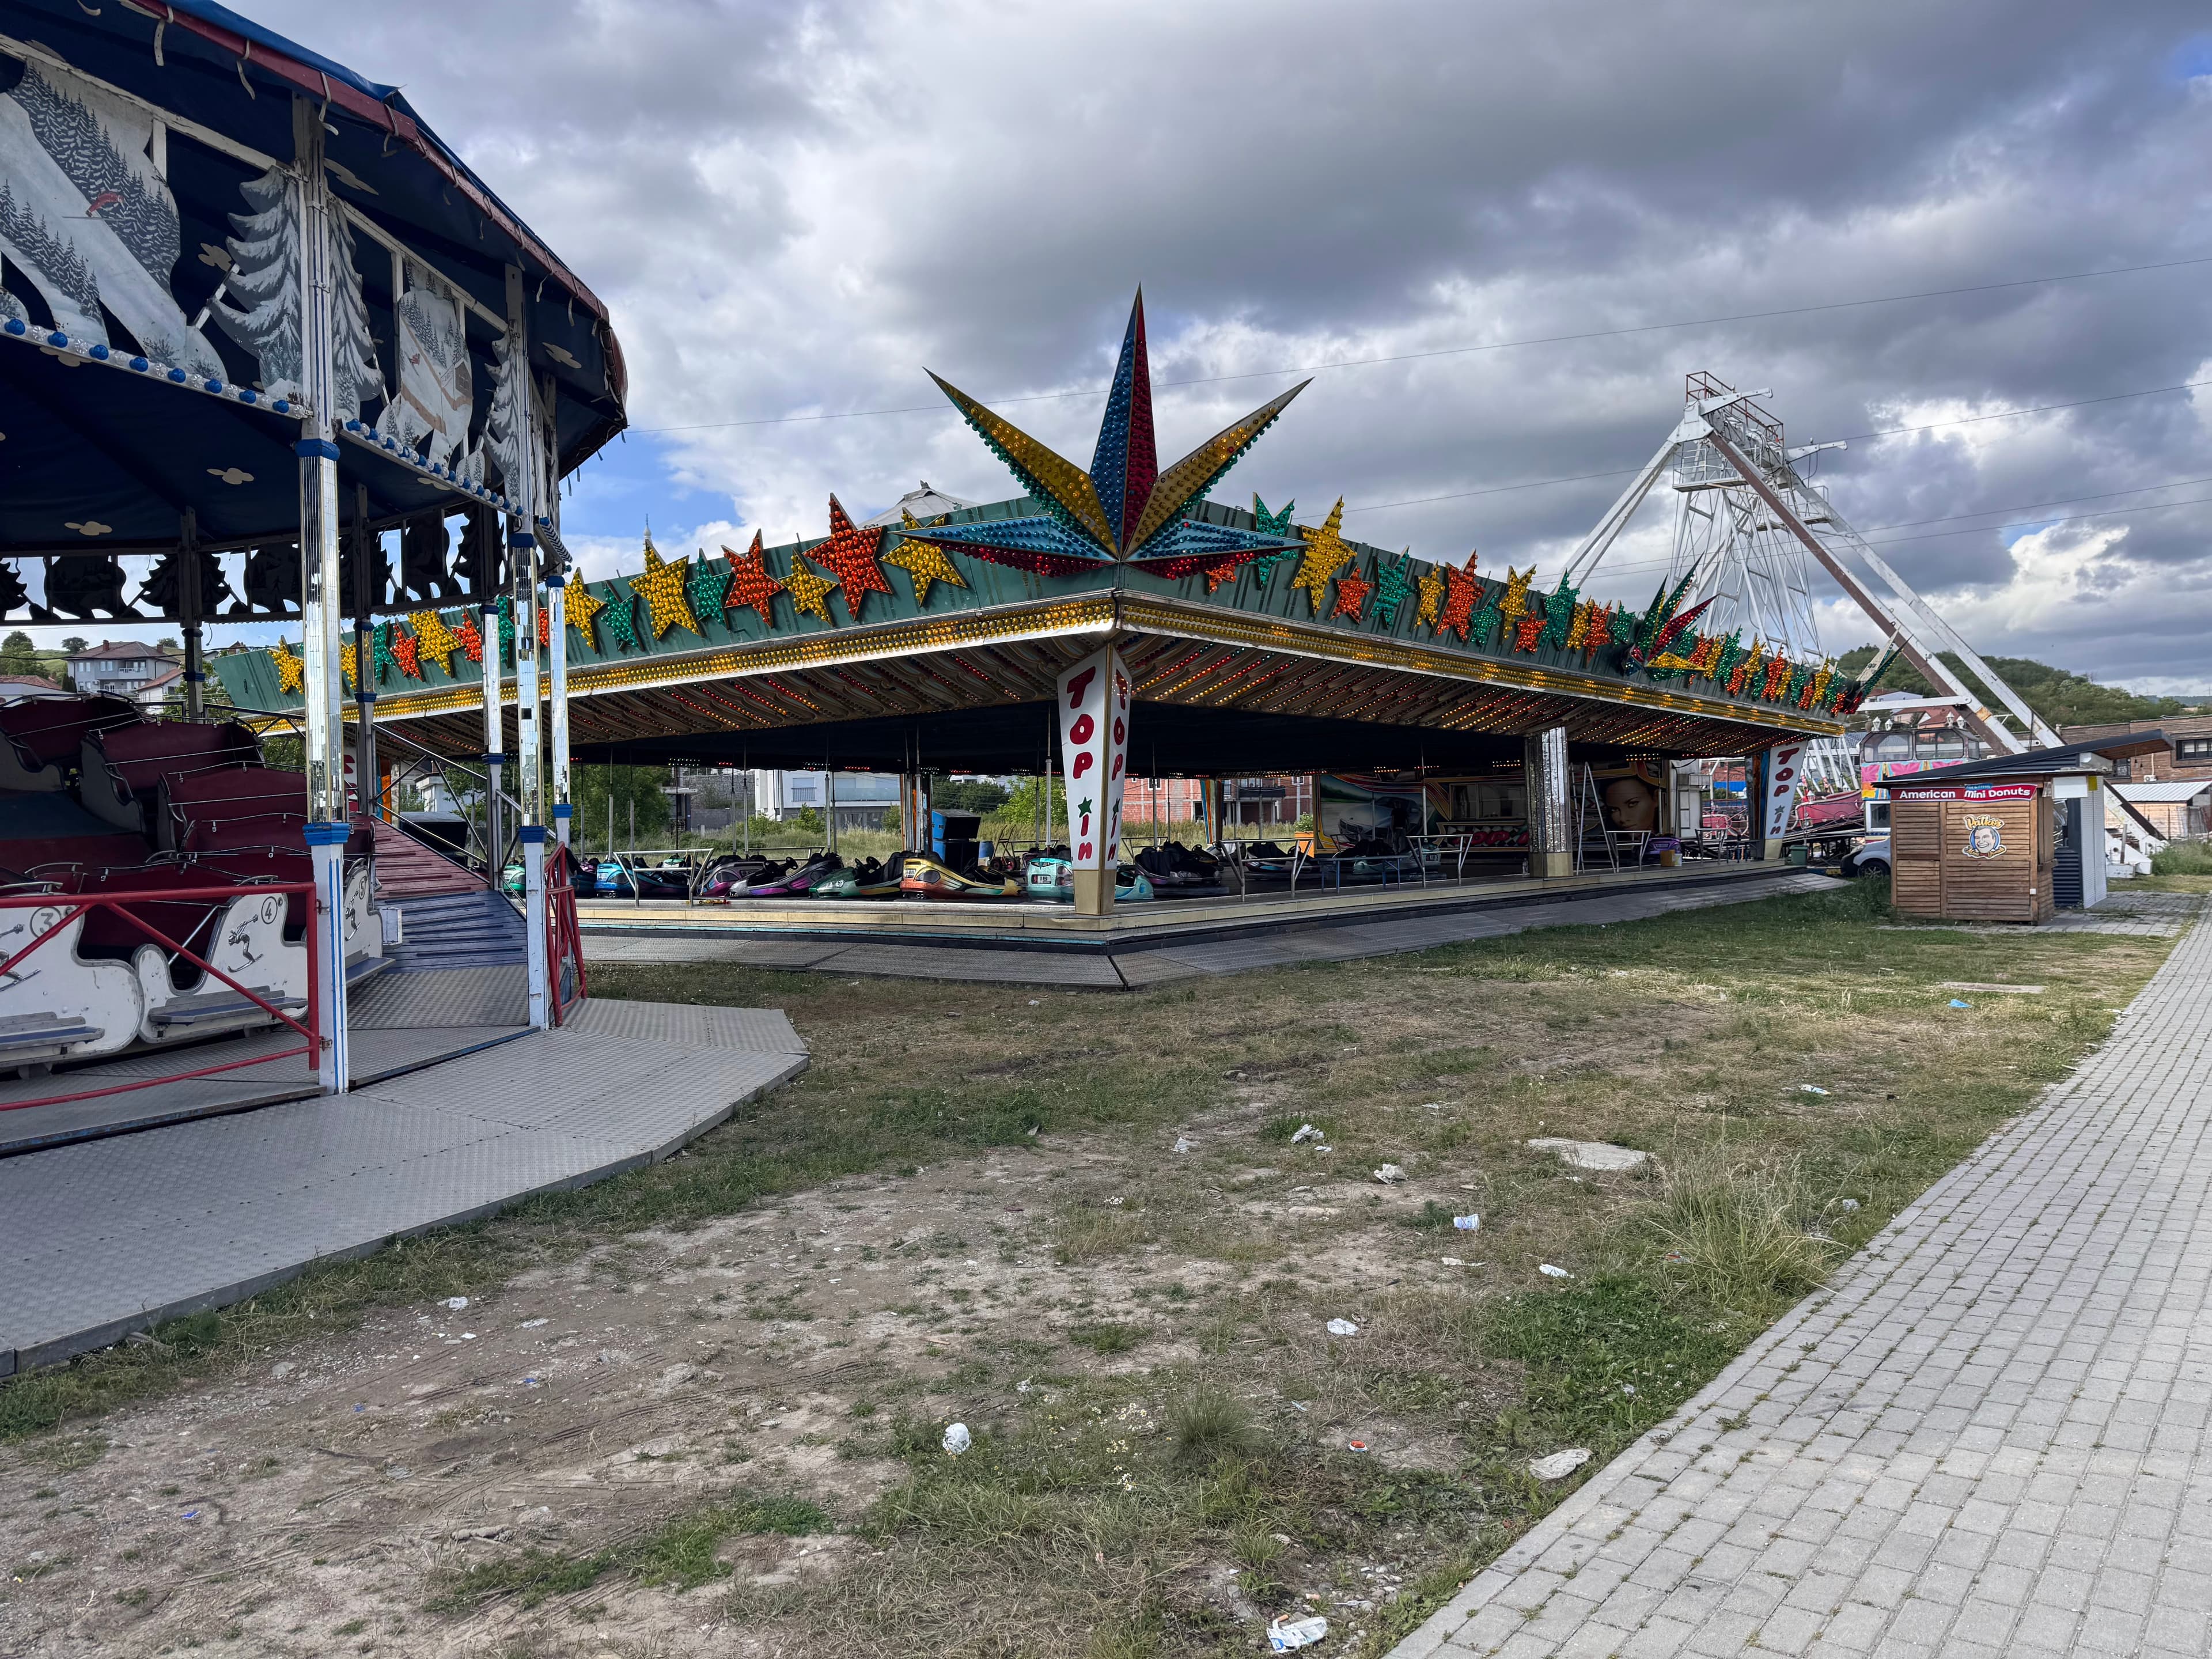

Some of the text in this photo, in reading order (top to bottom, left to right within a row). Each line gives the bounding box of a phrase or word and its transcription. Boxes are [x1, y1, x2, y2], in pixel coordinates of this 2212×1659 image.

[1066, 666, 1096, 779] TOP
[1112, 668, 1128, 781] TOP
[1774, 747, 1800, 797] TOP
[1899, 790, 1956, 799] American
[1964, 790, 1986, 799] Mini
[1989, 787, 2031, 798] Donuts
[360, 881, 365, 896] 5
[264, 902, 272, 920] 4
[39, 912, 54, 934] 3
